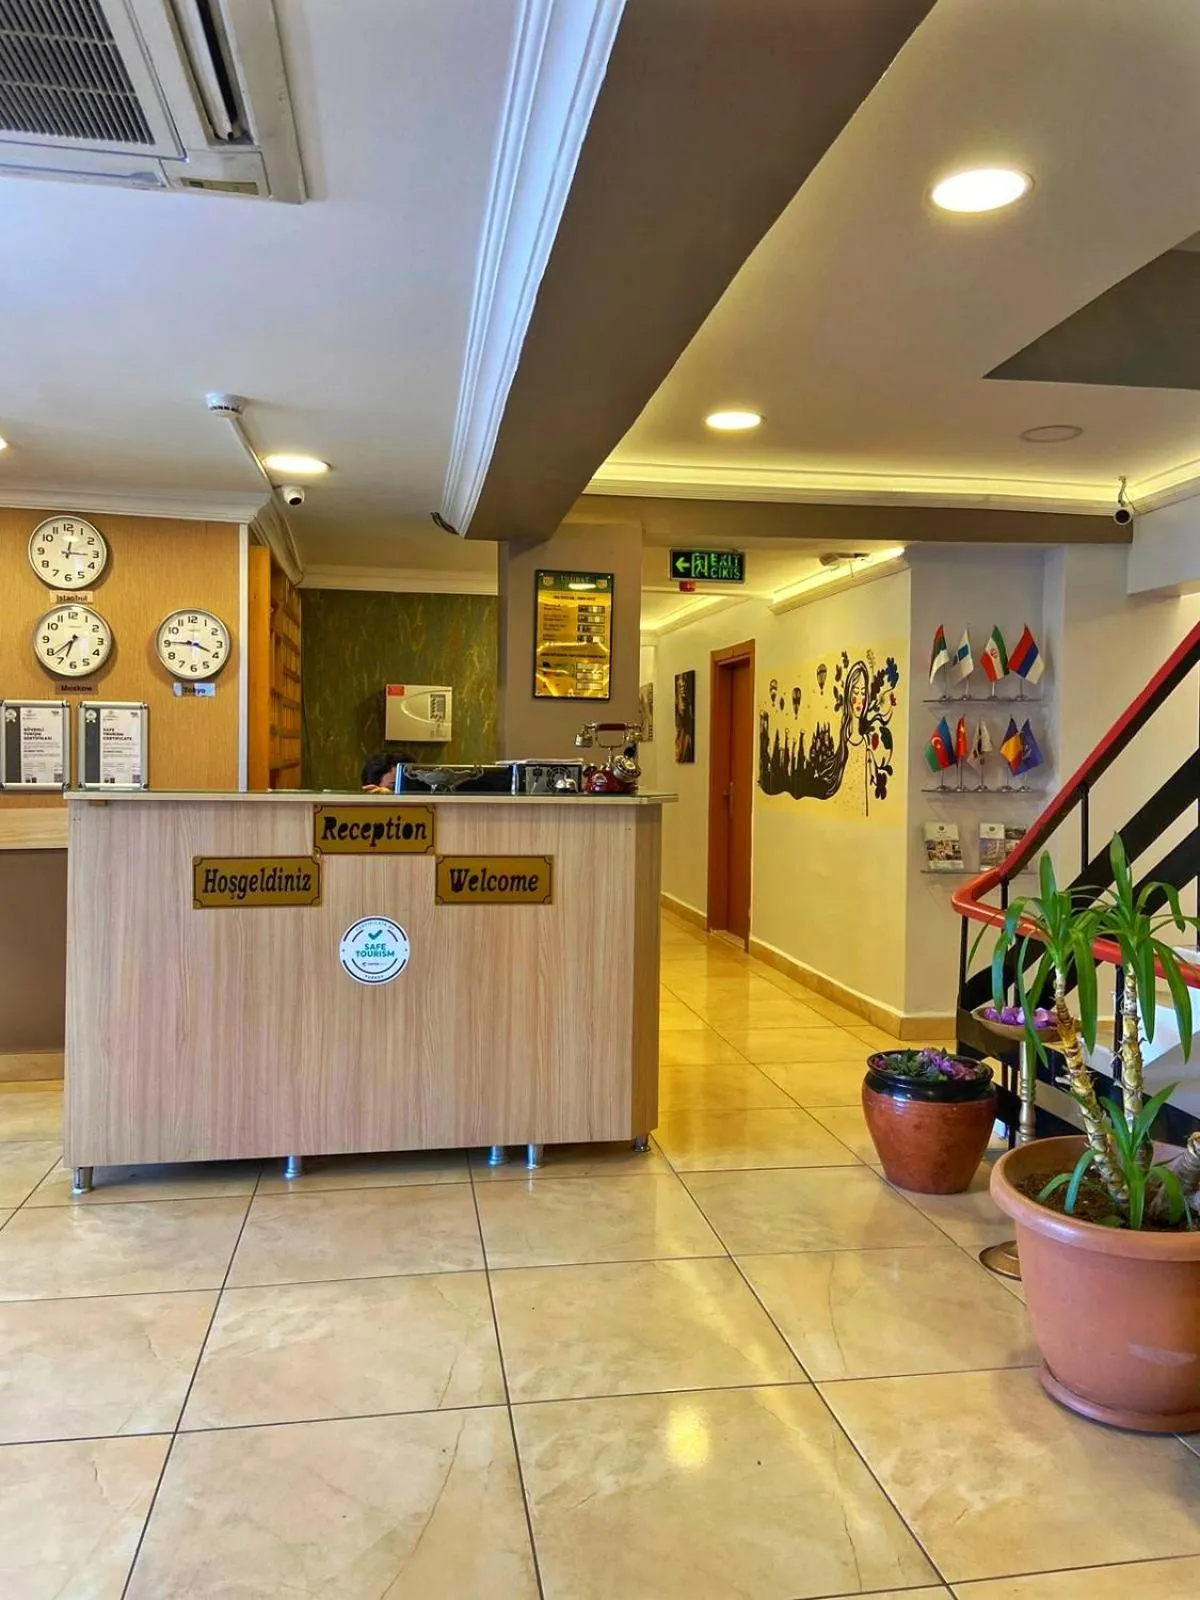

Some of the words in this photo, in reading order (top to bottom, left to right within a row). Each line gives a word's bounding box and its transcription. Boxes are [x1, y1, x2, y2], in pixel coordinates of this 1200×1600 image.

[53, 526, 59, 534] 11
[63, 523, 74, 531] 12
[42, 534, 53, 542] 10
[87, 536, 95, 545] 2
[37, 547, 45, 555] 9
[92, 550, 100, 559] 3
[711, 553, 739, 566] EXIT
[41, 560, 49, 568] 8
[52, 569, 59, 577] 7
[77, 571, 85, 579] 5
[64, 574, 72, 582] 6
[57, 615, 63, 623] 11
[68, 612, 78, 620] 12
[188, 615, 198, 624] 12
[48, 622, 59, 631] 10
[178, 619, 183, 627] 11
[92, 624, 99, 633] 2
[168, 627, 179, 635] 10
[211, 628, 218, 636] 2
[42, 635, 50, 644] 9
[97, 637, 104, 646] 3
[164, 640, 171, 648] 9
[216, 640, 223, 649] 3
[46, 648, 55, 656] 8
[92, 648, 100, 657] 4
[168, 652, 176, 660] 8
[57, 657, 64, 665] 7
[69, 661, 77, 669] 6
[82, 658, 90, 666] 5
[179, 660, 185, 668] 7
[202, 661, 210, 669] 5
[190, 664, 198, 672] 6
[321, 816, 428, 847] Reception
[202, 868, 312, 899] Hoşgeldiniz
[449, 868, 539, 893] Welcome
[355, 950, 395, 958] TOURISM
